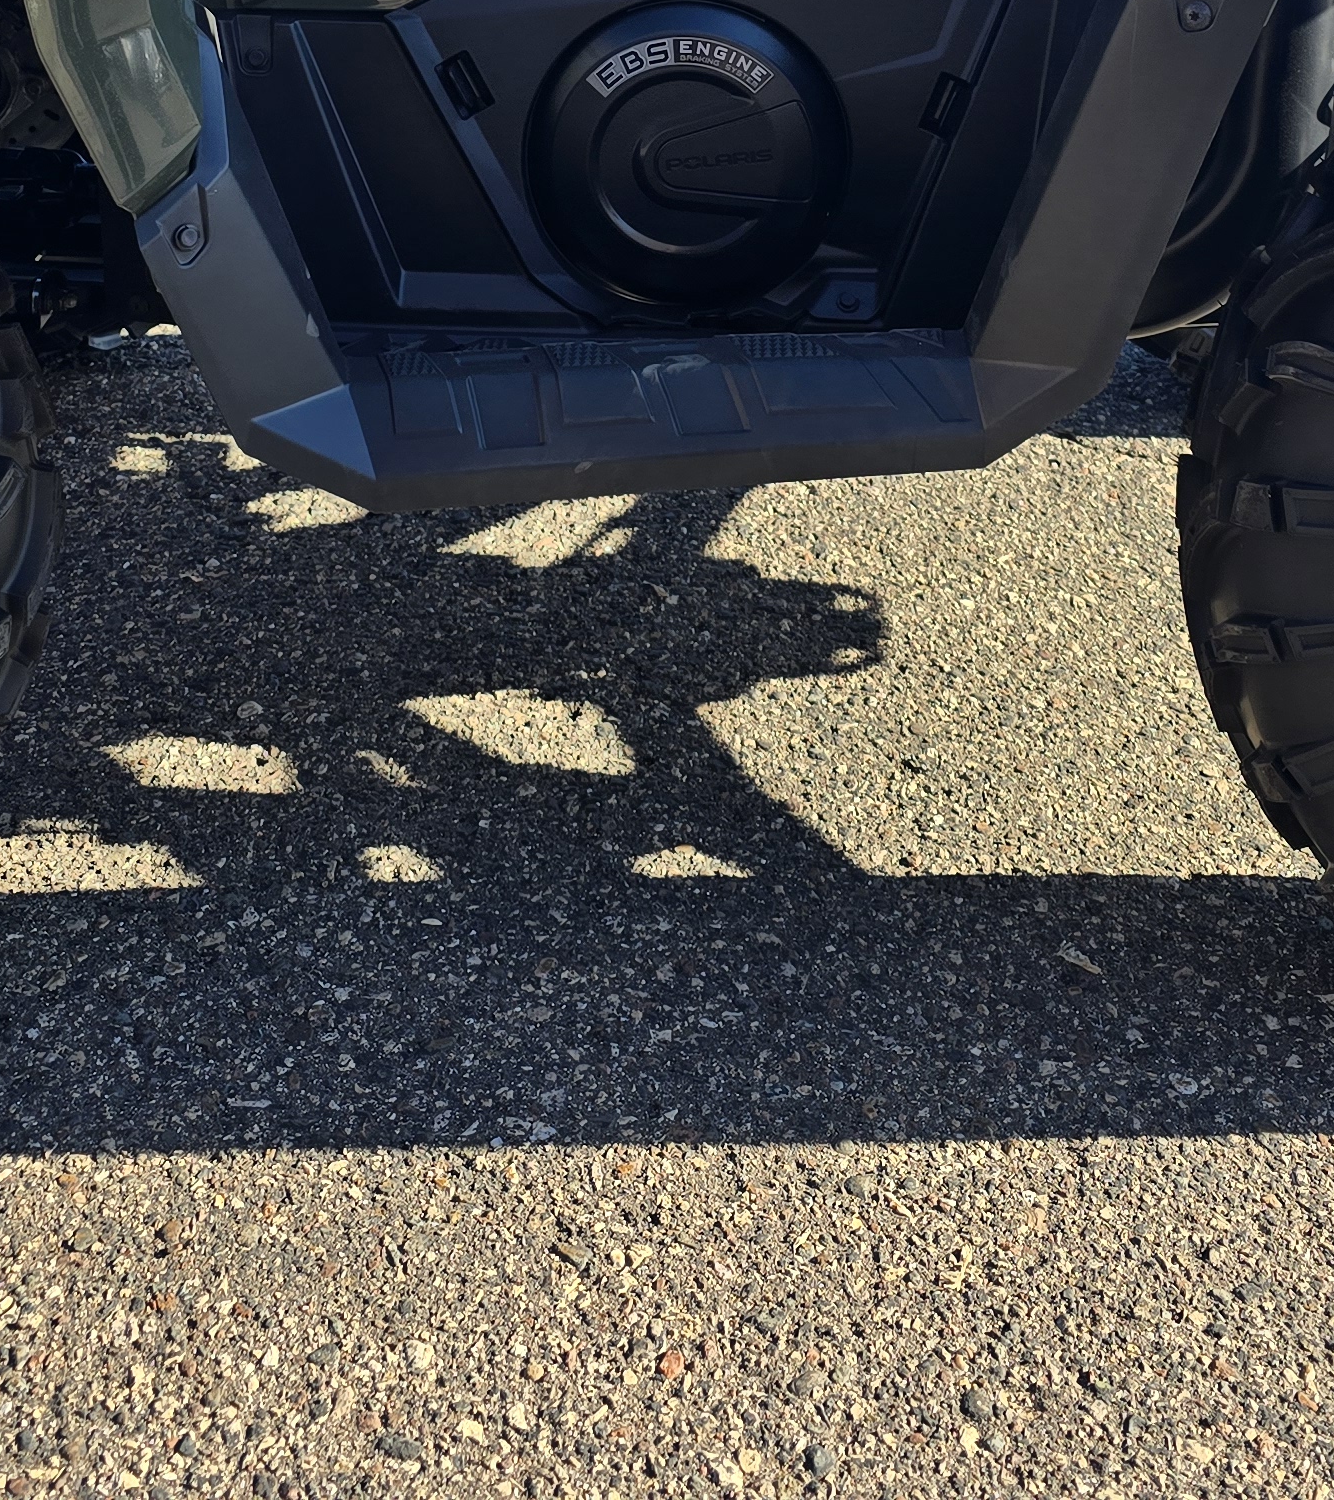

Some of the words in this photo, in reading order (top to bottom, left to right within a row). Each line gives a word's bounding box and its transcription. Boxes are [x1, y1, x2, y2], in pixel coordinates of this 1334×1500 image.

[595, 41, 670, 90] EBS
[679, 40, 768, 82] ENGINE
[679, 55, 720, 67] BRAKING
[724, 63, 760, 89] SYSTEM
[666, 150, 774, 172] POLARIS
